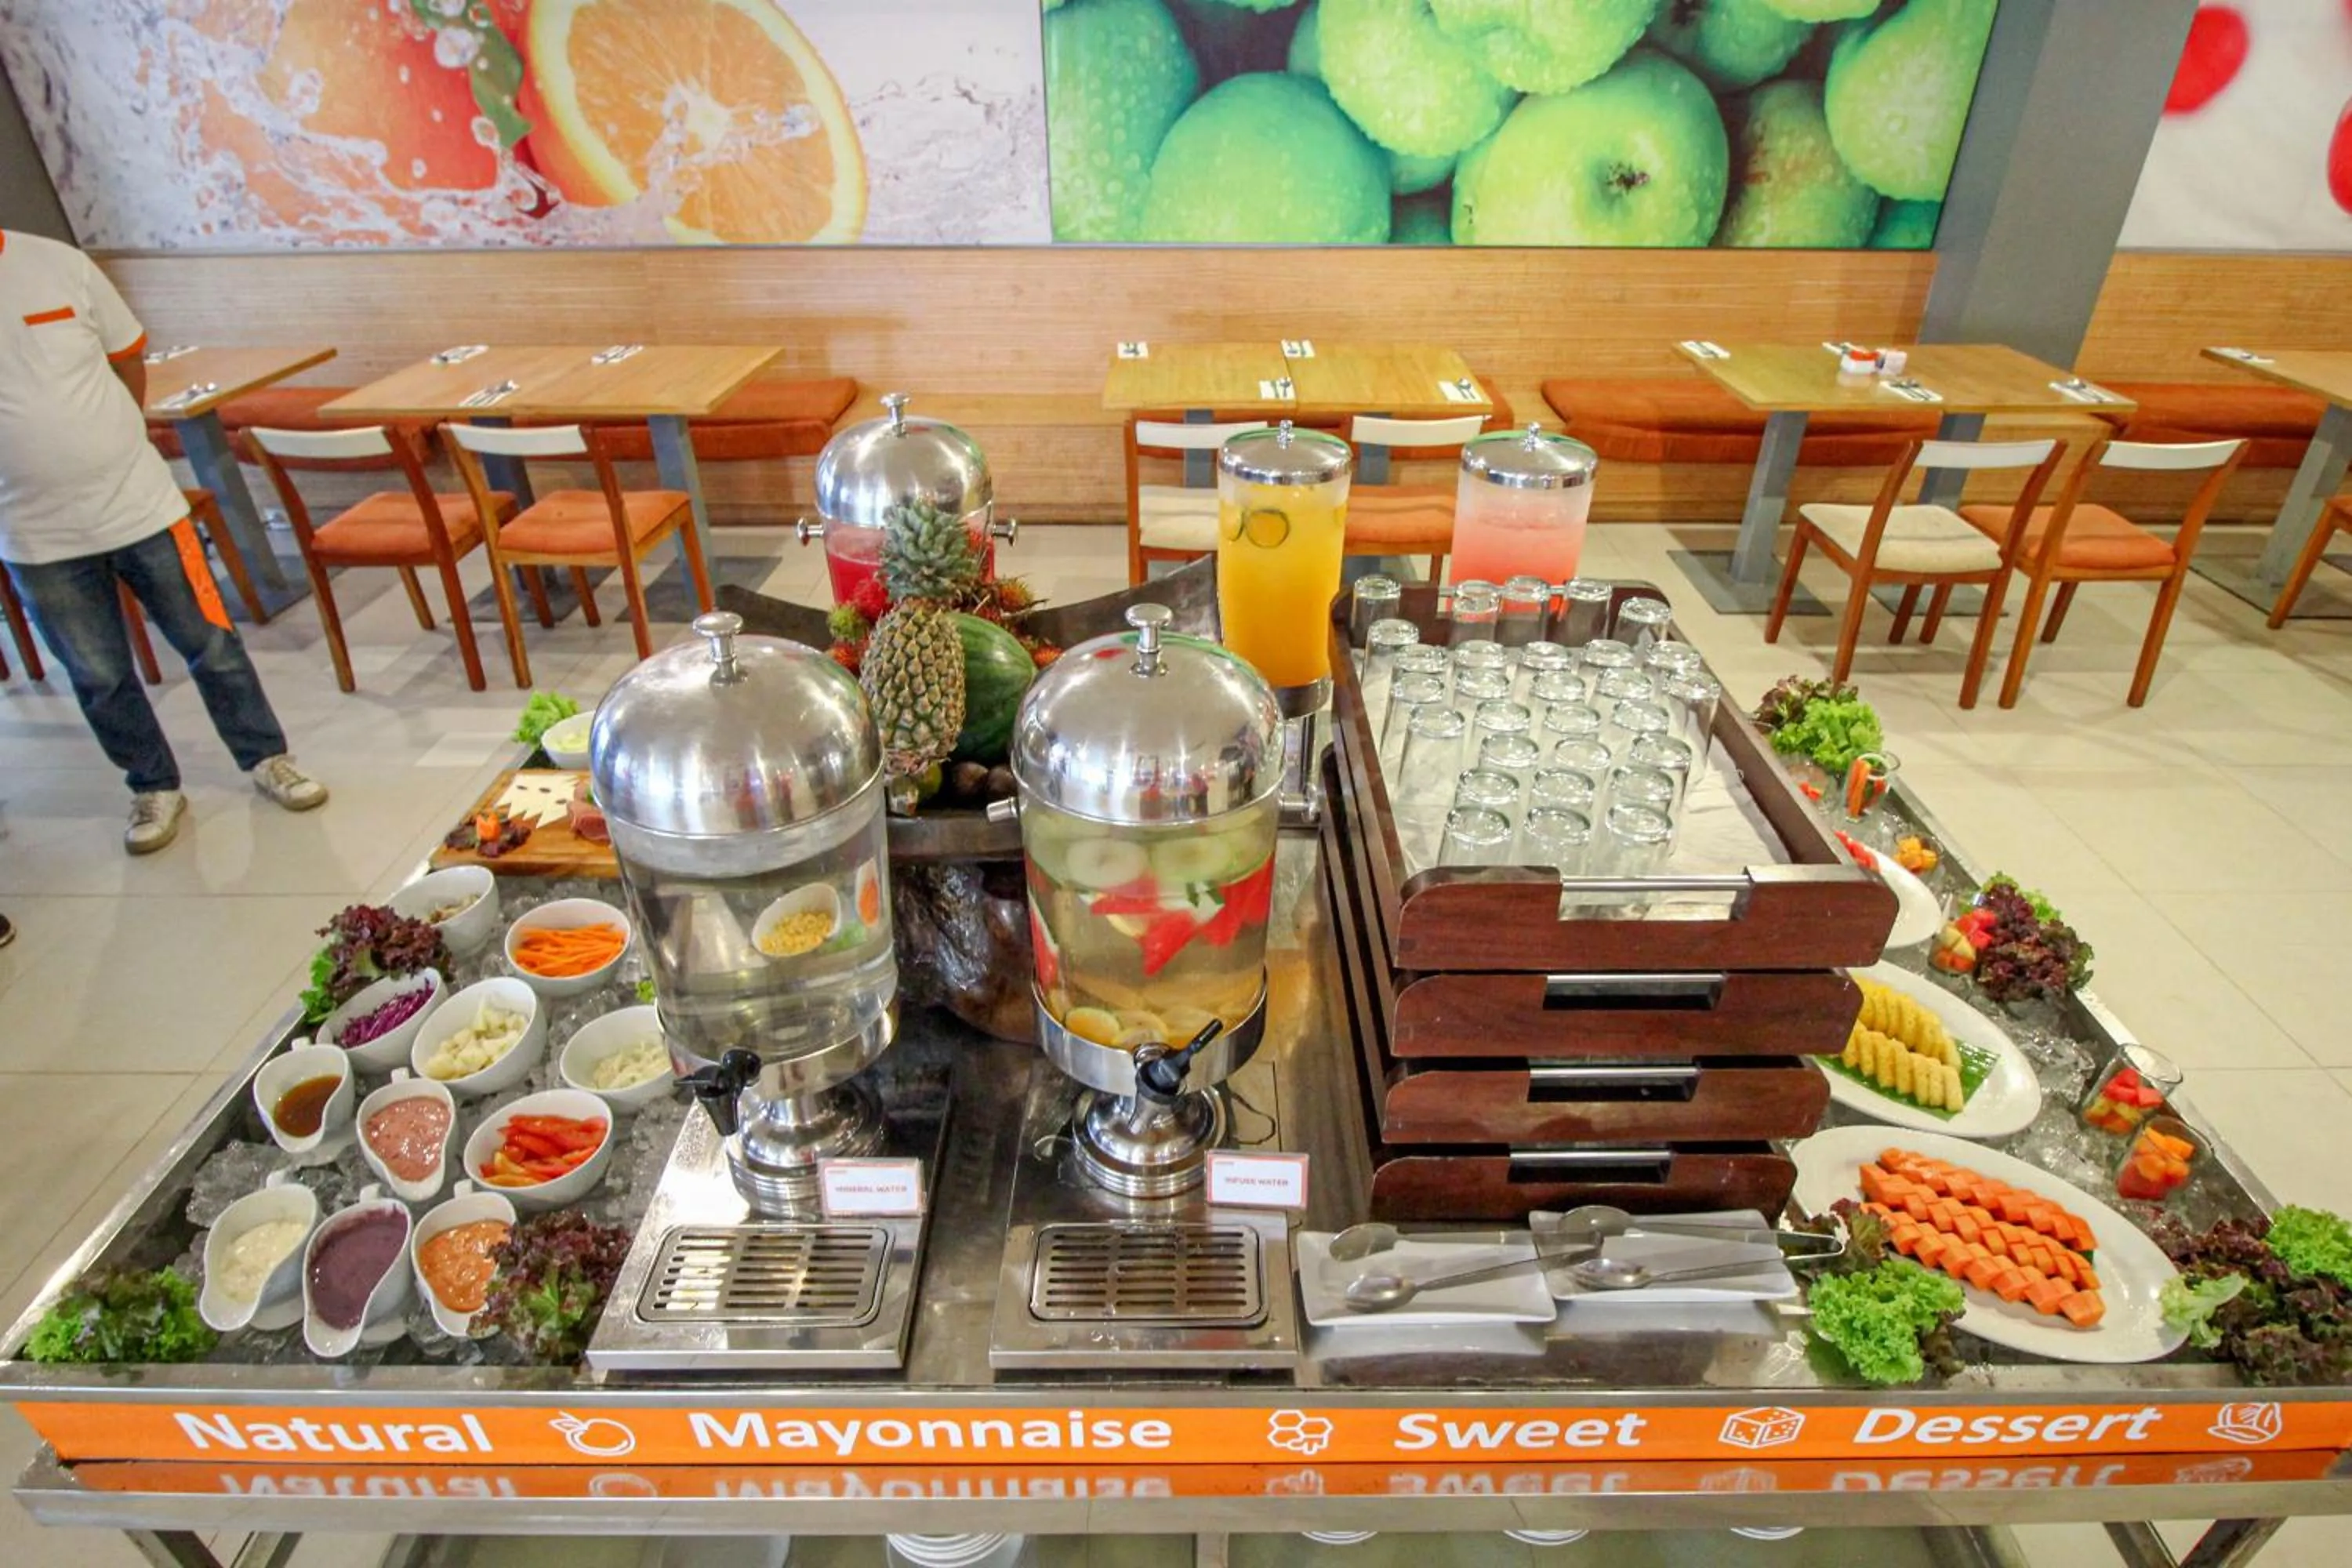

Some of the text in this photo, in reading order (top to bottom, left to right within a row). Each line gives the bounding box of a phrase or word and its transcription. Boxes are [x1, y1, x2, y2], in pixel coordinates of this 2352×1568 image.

[835, 1184, 908, 1193] MINERAL WATER
[173, 1412, 492, 1453] Natural
[688, 1409, 1172, 1457] Mayonnaise
[1394, 1413, 1648, 1450] Sweet
[1853, 1407, 2162, 1444] Dessert
